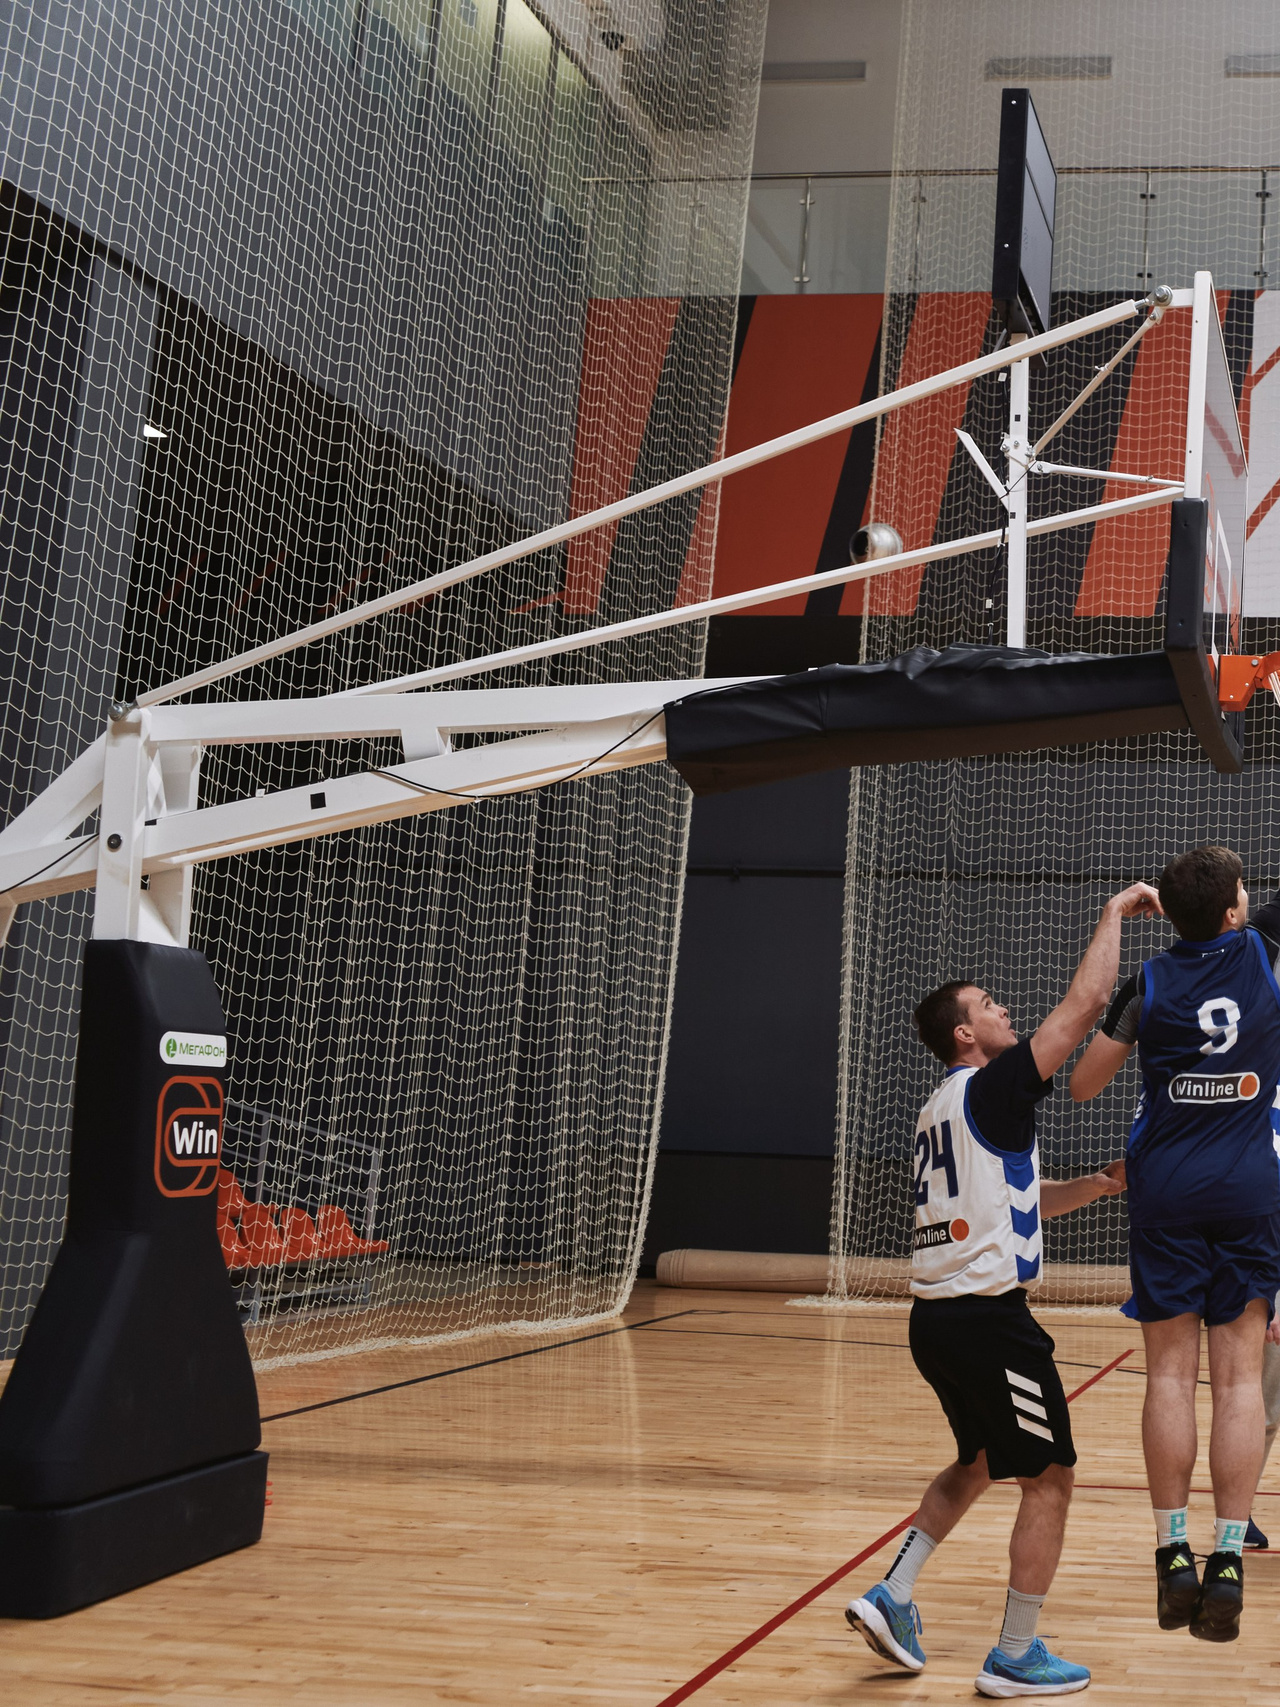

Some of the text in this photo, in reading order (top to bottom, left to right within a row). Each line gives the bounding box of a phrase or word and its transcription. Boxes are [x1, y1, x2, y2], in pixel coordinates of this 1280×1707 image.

[1197, 996, 1241, 1057] 9
[1176, 1079, 1234, 1098] Winline
[173, 1121, 217, 1155] Win
[914, 1119, 959, 1206] 24
